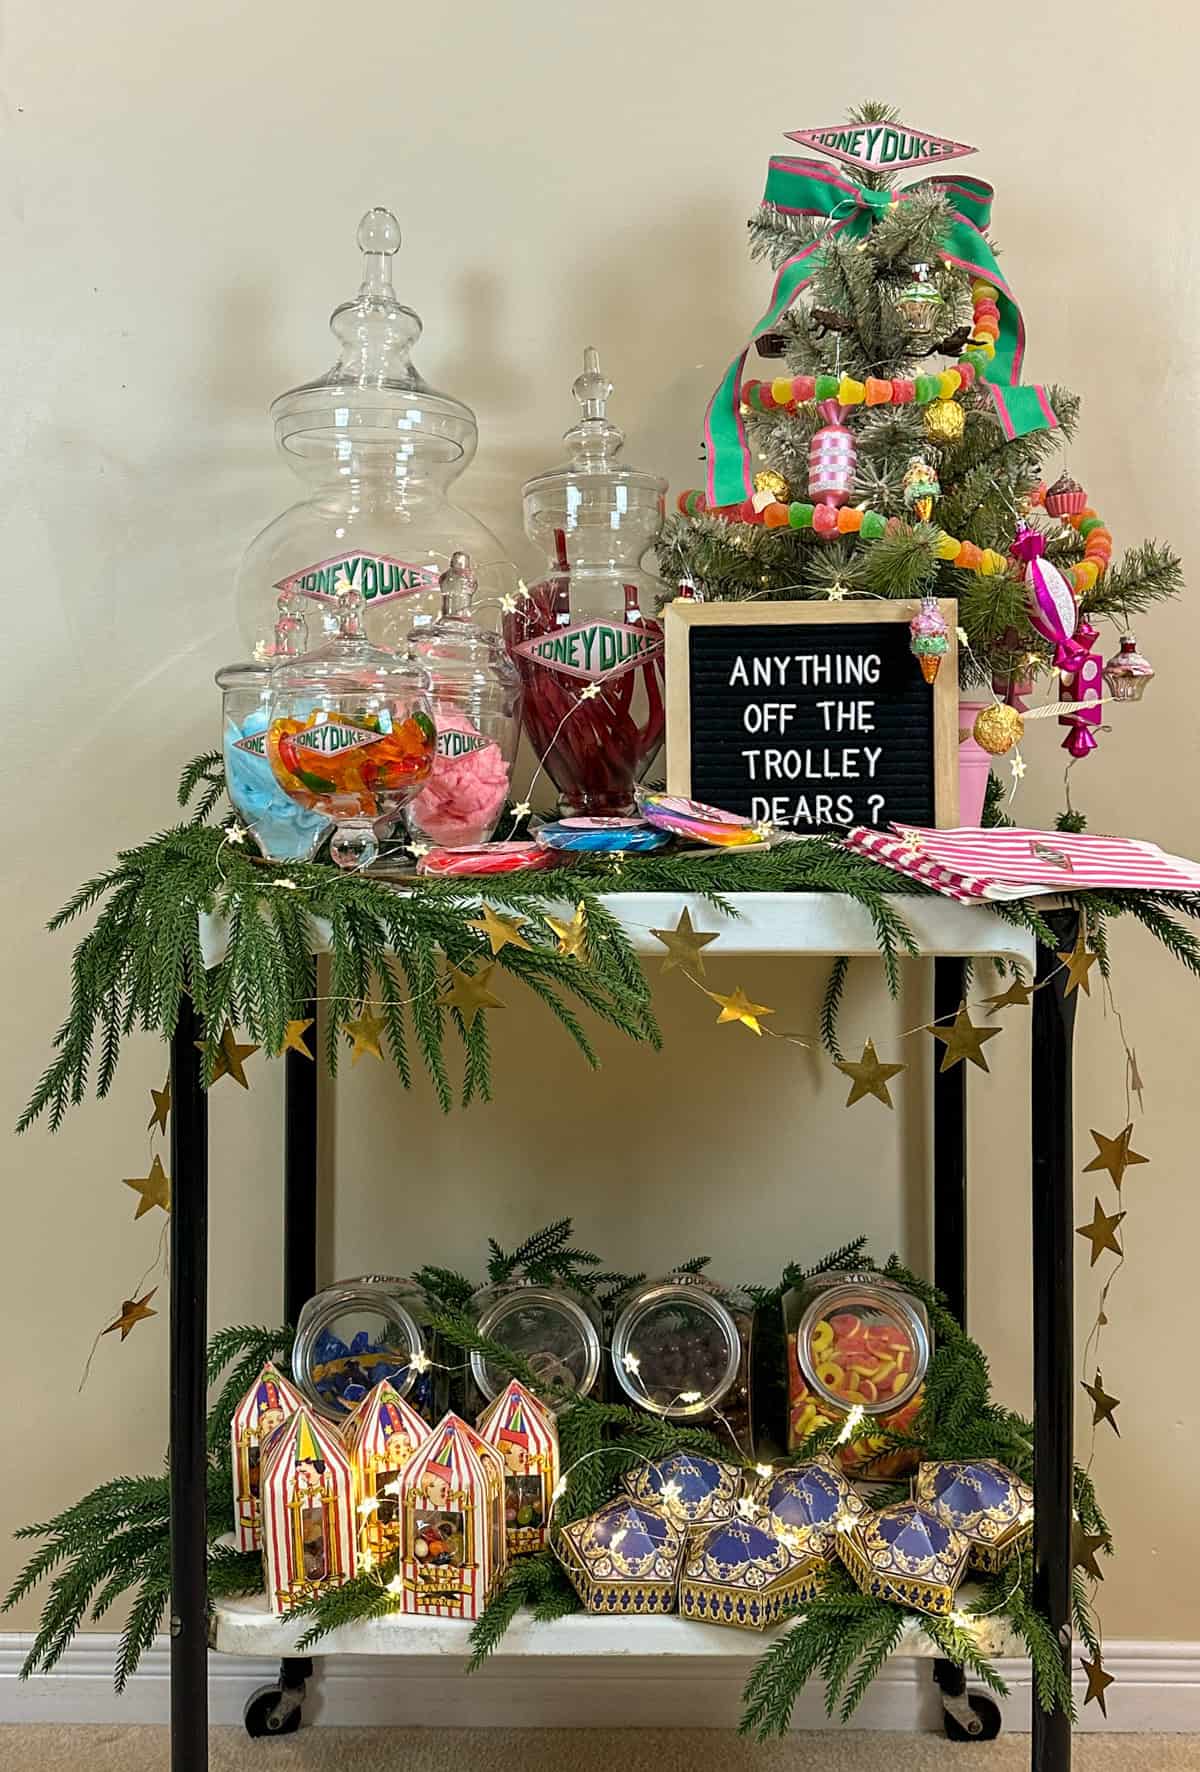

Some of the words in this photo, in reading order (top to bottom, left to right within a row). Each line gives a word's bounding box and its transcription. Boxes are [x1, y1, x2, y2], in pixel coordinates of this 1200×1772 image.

[811, 127, 954, 163] HONEYDUKES
[729, 654, 881, 687] ANYTHING
[743, 703, 797, 735] OFF
[816, 701, 875, 733] THE
[741, 747, 882, 780] TROLLEY
[752, 795, 854, 826] DEARS
